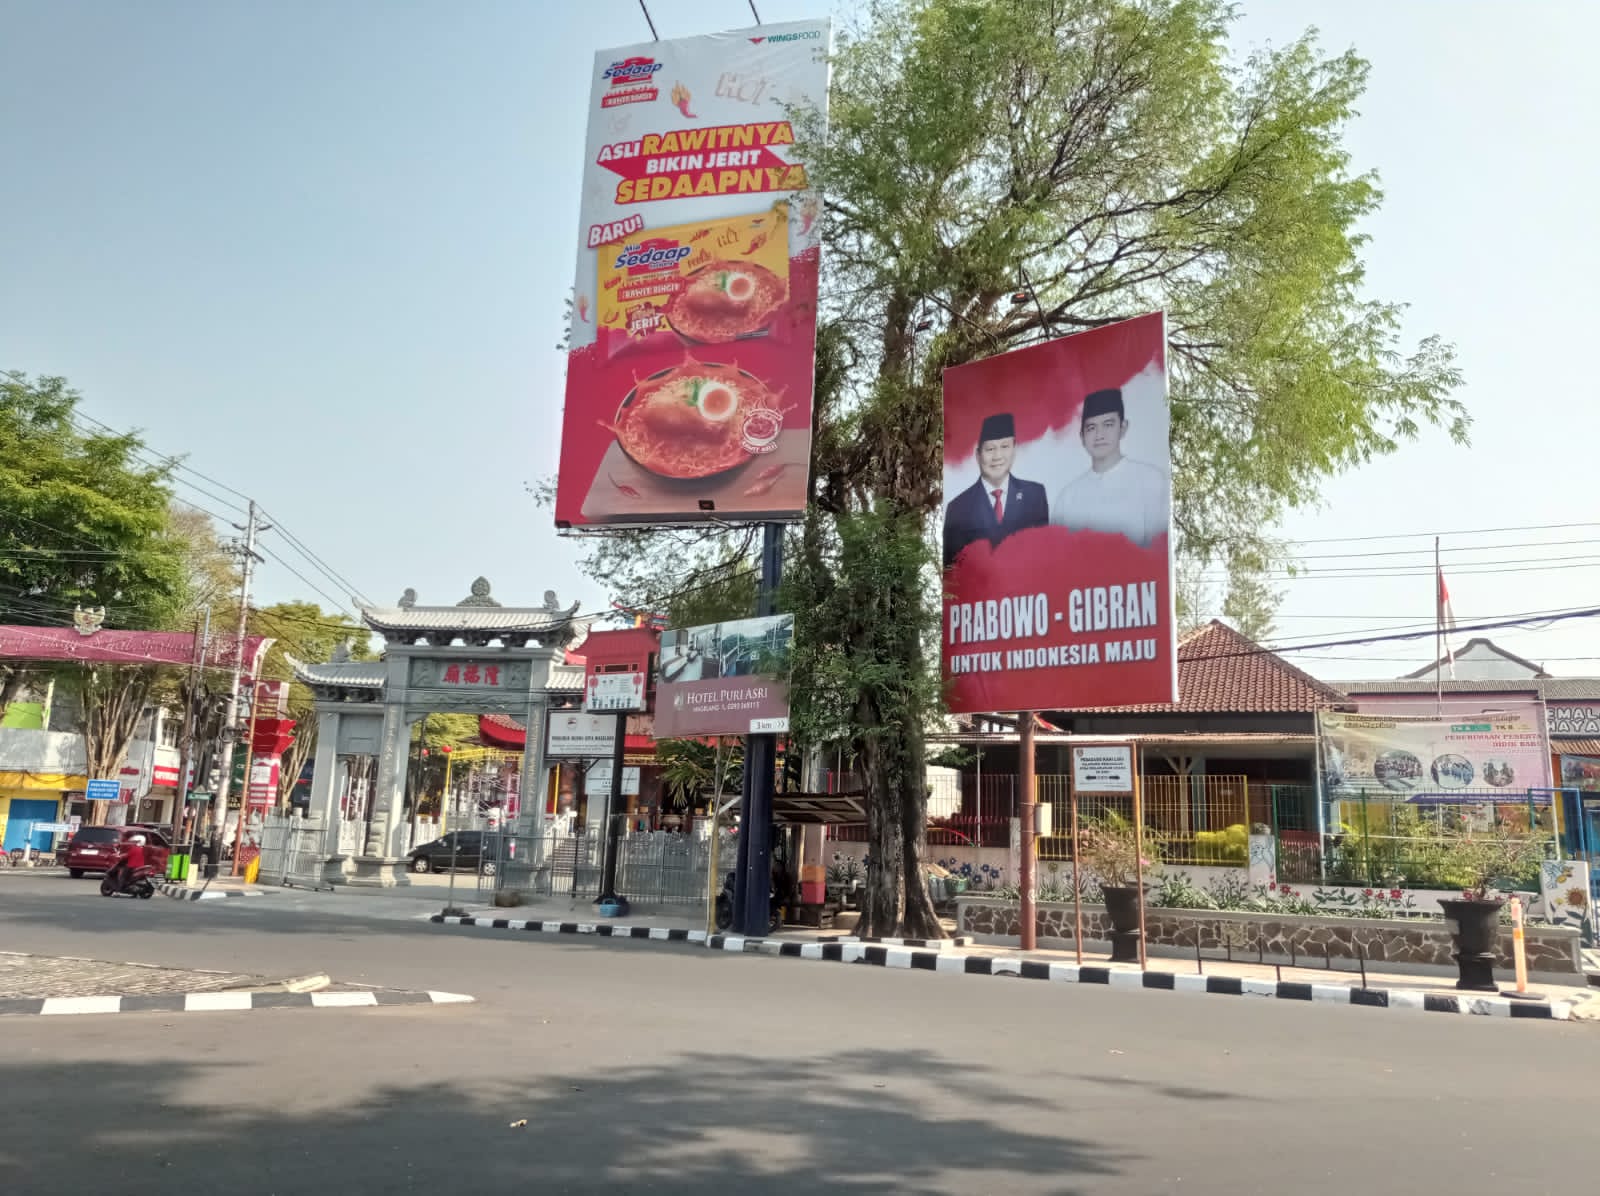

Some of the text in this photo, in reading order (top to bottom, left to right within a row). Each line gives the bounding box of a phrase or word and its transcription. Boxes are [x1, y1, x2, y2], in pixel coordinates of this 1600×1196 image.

[601, 63, 662, 79] Sedaap
[599, 121, 793, 162] ASLI RAWITNYA
[646, 150, 761, 174] BIKIN JERIT
[615, 166, 808, 204] SEDAAPNYA
[589, 215, 643, 247] BARU!
[613, 246, 691, 269] Sedaap
[950, 592, 1048, 644] PRABOWO
[1069, 581, 1157, 633] GIBRAN
[951, 639, 1157, 673] UNTUK INDONESIA MAJU
[687, 687, 768, 704] HOTEL PURI ASRI
[1547, 707, 1600, 721] EMAL
